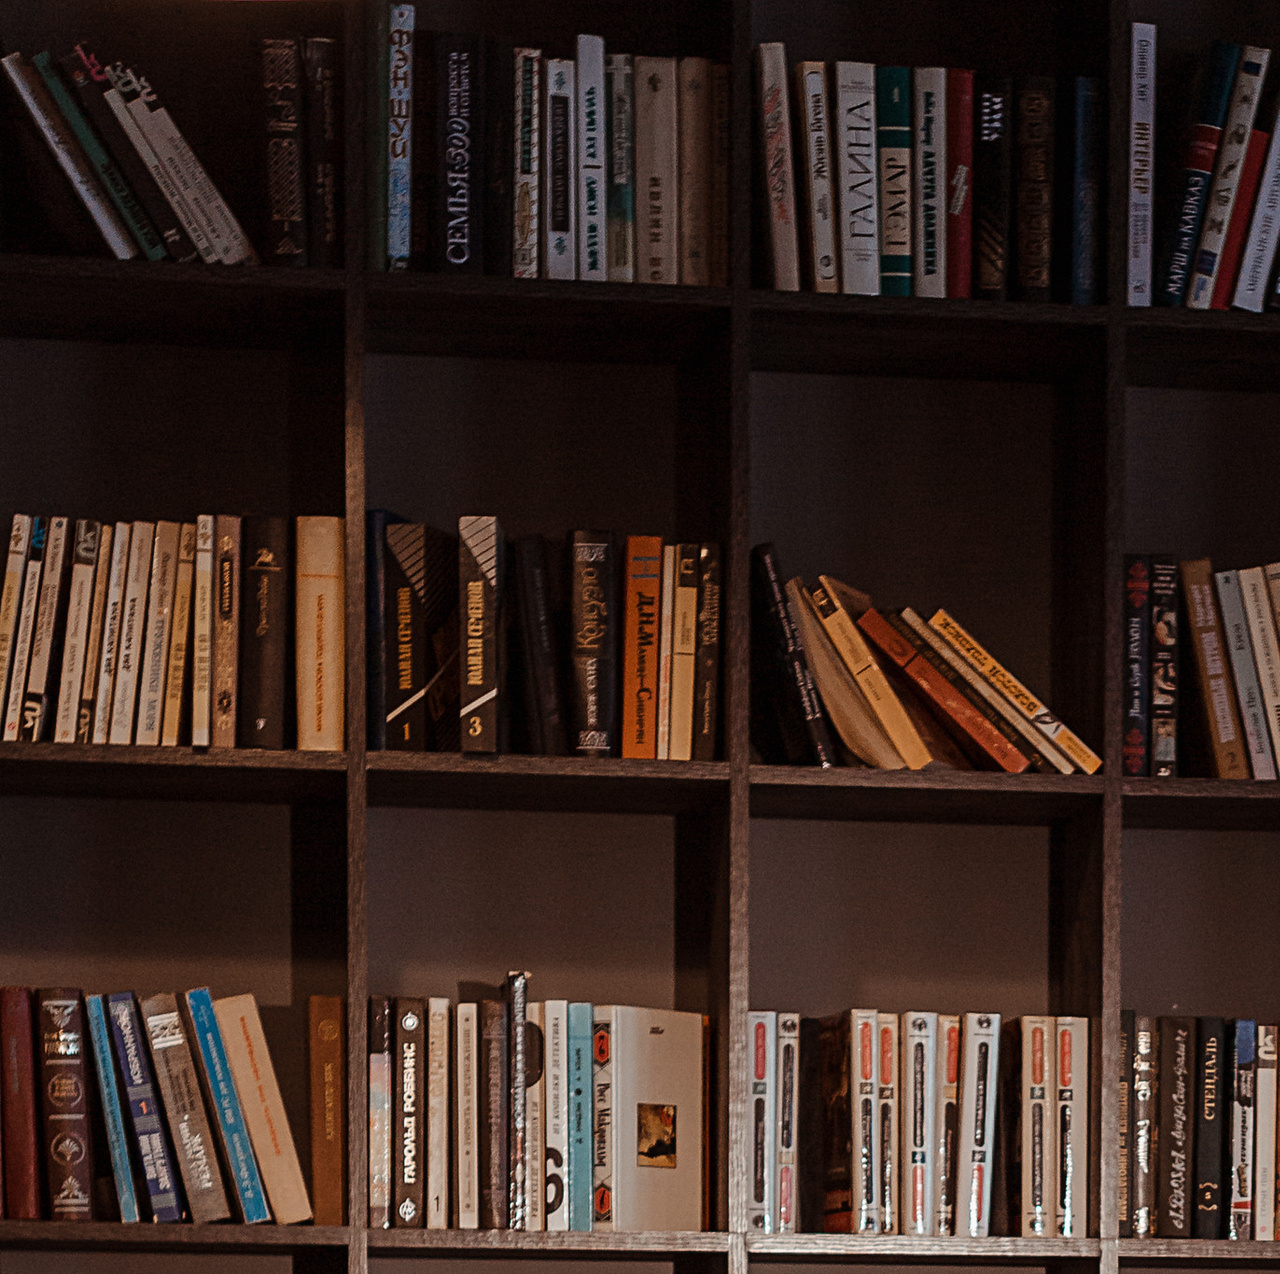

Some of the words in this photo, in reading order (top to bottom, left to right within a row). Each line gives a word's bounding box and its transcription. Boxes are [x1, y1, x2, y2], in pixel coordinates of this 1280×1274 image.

[845, 99, 875, 239] ГАЛИНА
[1133, 121, 1149, 195] ИНТЕРЬЕР
[1167, 251, 1187, 295] МАРШ
[1180, 174, 1203, 234] КАВКАЗ
[403, 1041, 415, 1113] РОББИНС
[1204, 1036, 1216, 1120] СТЕНДАЛЬ
[403, 1116, 415, 1183] ГАРОЛЬД
